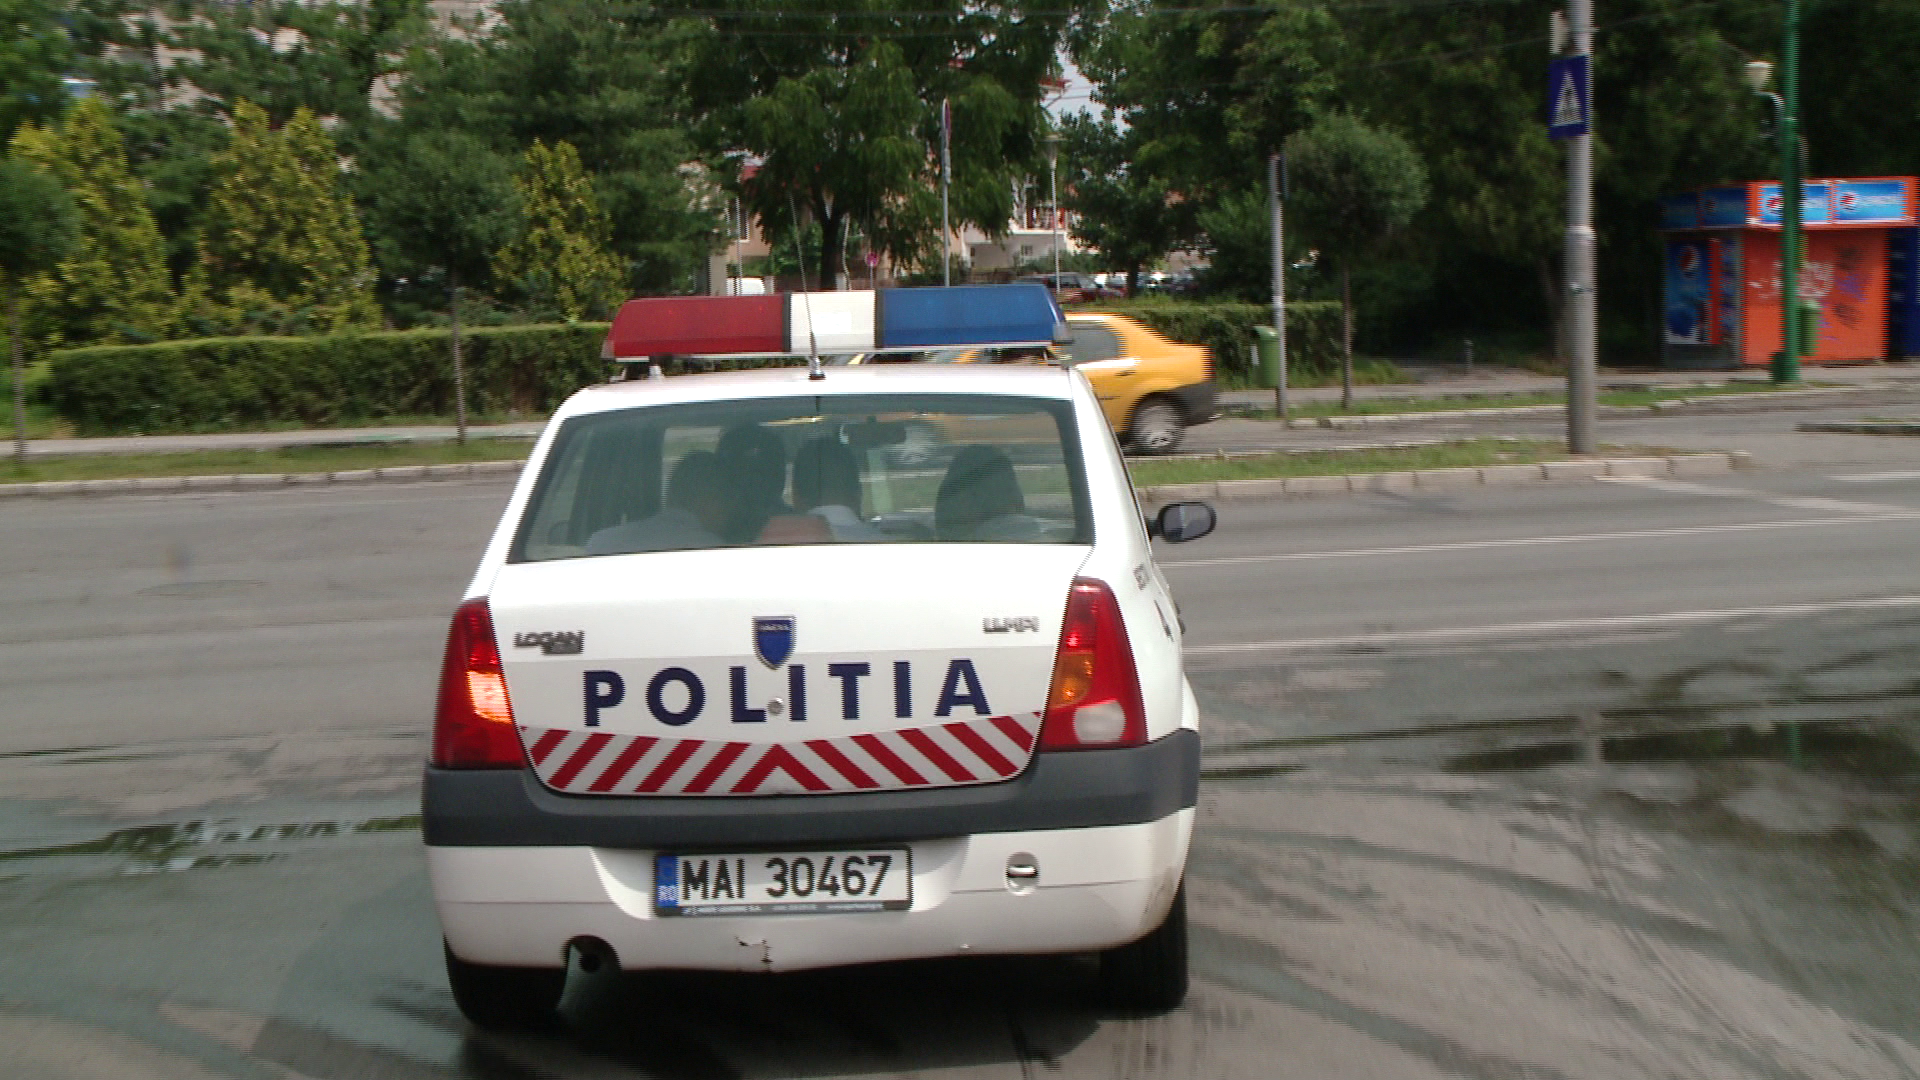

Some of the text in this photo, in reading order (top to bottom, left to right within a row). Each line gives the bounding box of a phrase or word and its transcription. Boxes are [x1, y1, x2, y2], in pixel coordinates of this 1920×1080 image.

[512, 630, 584, 648] LOGAN
[582, 658, 992, 727] POLITIA
[680, 855, 893, 900] MAI 30467
[657, 885, 678, 902] RO
